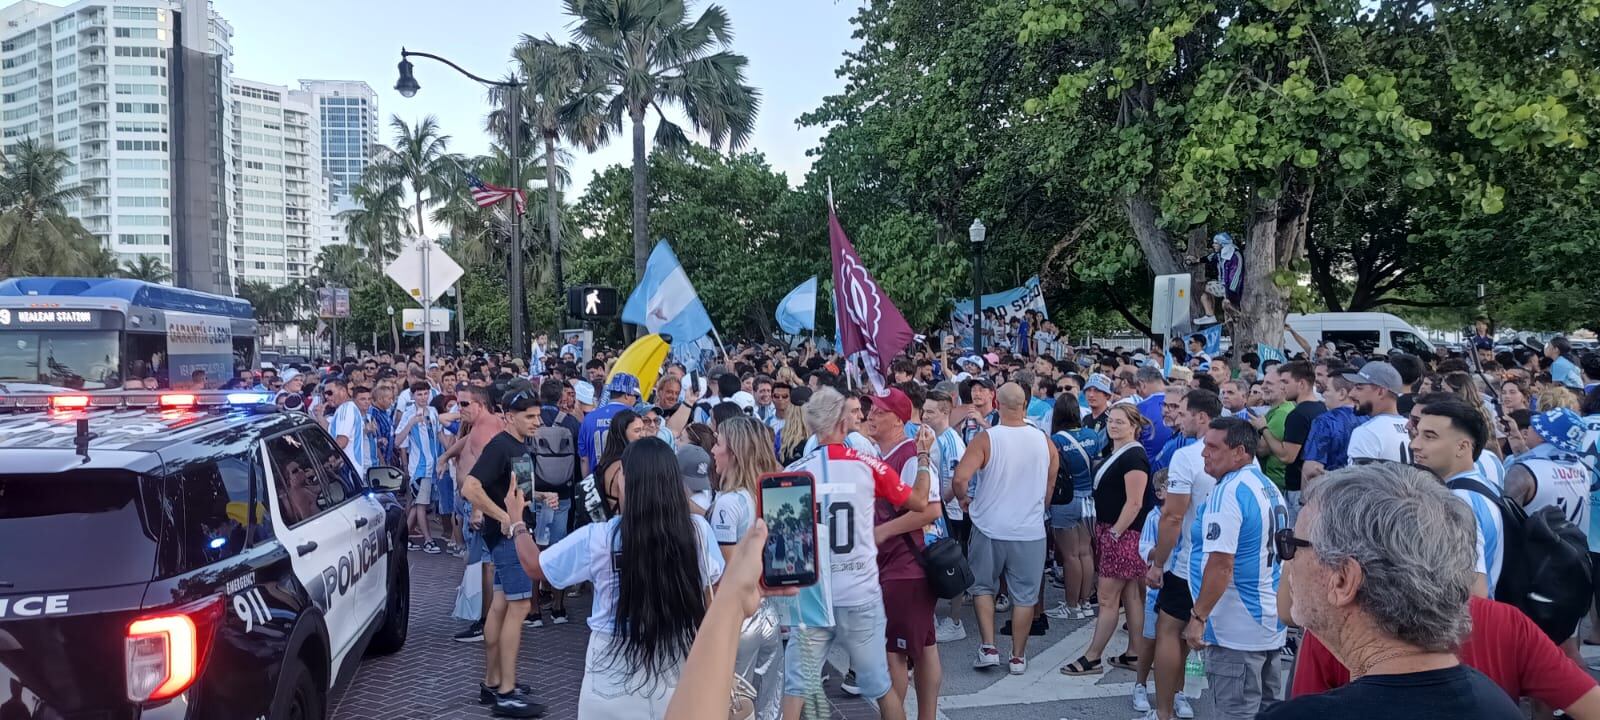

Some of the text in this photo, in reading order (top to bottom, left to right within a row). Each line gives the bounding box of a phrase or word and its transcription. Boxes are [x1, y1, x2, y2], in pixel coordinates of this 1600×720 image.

[56, 311, 91, 322] STATION
[226, 571, 256, 596] EMERGENCY
[321, 530, 378, 612] POLICE
[233, 587, 272, 633] 911
